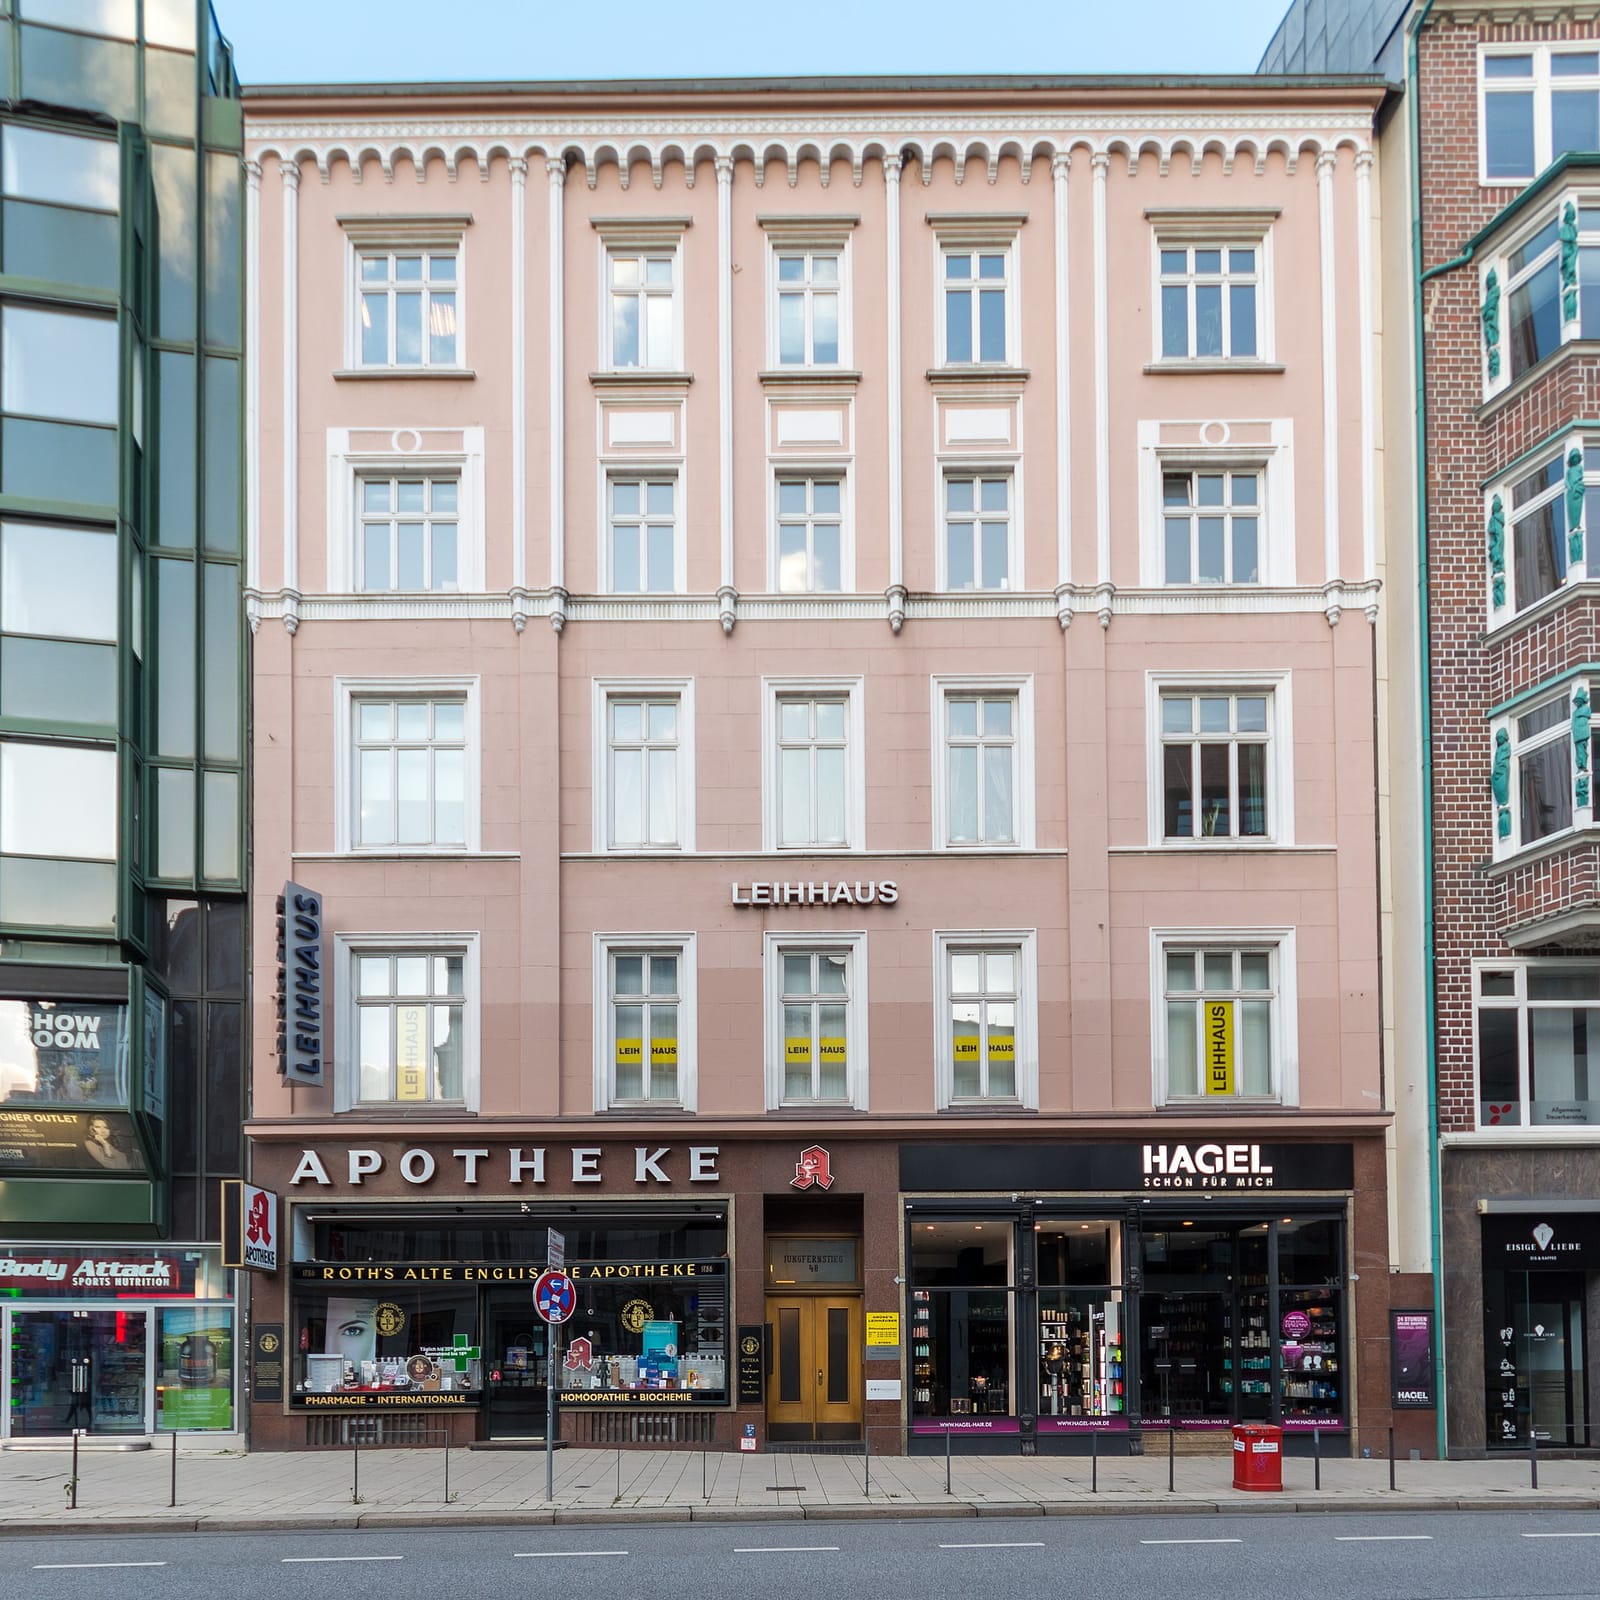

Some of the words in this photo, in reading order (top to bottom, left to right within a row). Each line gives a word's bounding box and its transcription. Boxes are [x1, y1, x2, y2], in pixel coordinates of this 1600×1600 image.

[731, 880, 899, 906] LEIHHAUS
[294, 893, 321, 1075] LEIHHAUS
[26, 1013, 101, 1032] HOW
[26, 1030, 100, 1049] OOM
[405, 1010, 418, 1095] LEIHHAUS
[618, 1047, 640, 1055] LEIH
[651, 1047, 677, 1055] HAUS
[787, 1046, 809, 1054] LEIH
[820, 1046, 846, 1054] HAUS
[955, 1044, 977, 1052] LEIH
[988, 1044, 1014, 1052] HAUS
[1211, 1005, 1226, 1091] LEIHHAUS
[34, 1114, 79, 1123] OUTLET
[288, 1146, 721, 1185] APOTHEKE
[1143, 1144, 1273, 1174] HAGEL
[1144, 1175, 1193, 1187] SCHÖN
[1202, 1176, 1228, 1187] FÜR
[1236, 1176, 1274, 1187] MICH
[1505, 1243, 1537, 1251] EISIGE
[1550, 1242, 1582, 1251] LIEBE
[245, 1245, 275, 1265] APOTHEKE
[783, 1255, 844, 1264] JUNGFERNSTIEG
[0, 1259, 67, 1281] Body
[72, 1260, 171, 1278] Attack
[323, 1267, 394, 1280] ROTH'S
[404, 1267, 453, 1280] ALTE
[590, 1263, 697, 1278] APOTHEKE
[72, 1277, 111, 1287] SPORTS
[115, 1277, 170, 1287] NUTRITION
[305, 1396, 366, 1405] PHARMACIE
[378, 1395, 465, 1404] INTERNATIONALE
[640, 1392, 692, 1401] BIOCHEMIE
[1398, 1391, 1429, 1399] HAGEL
